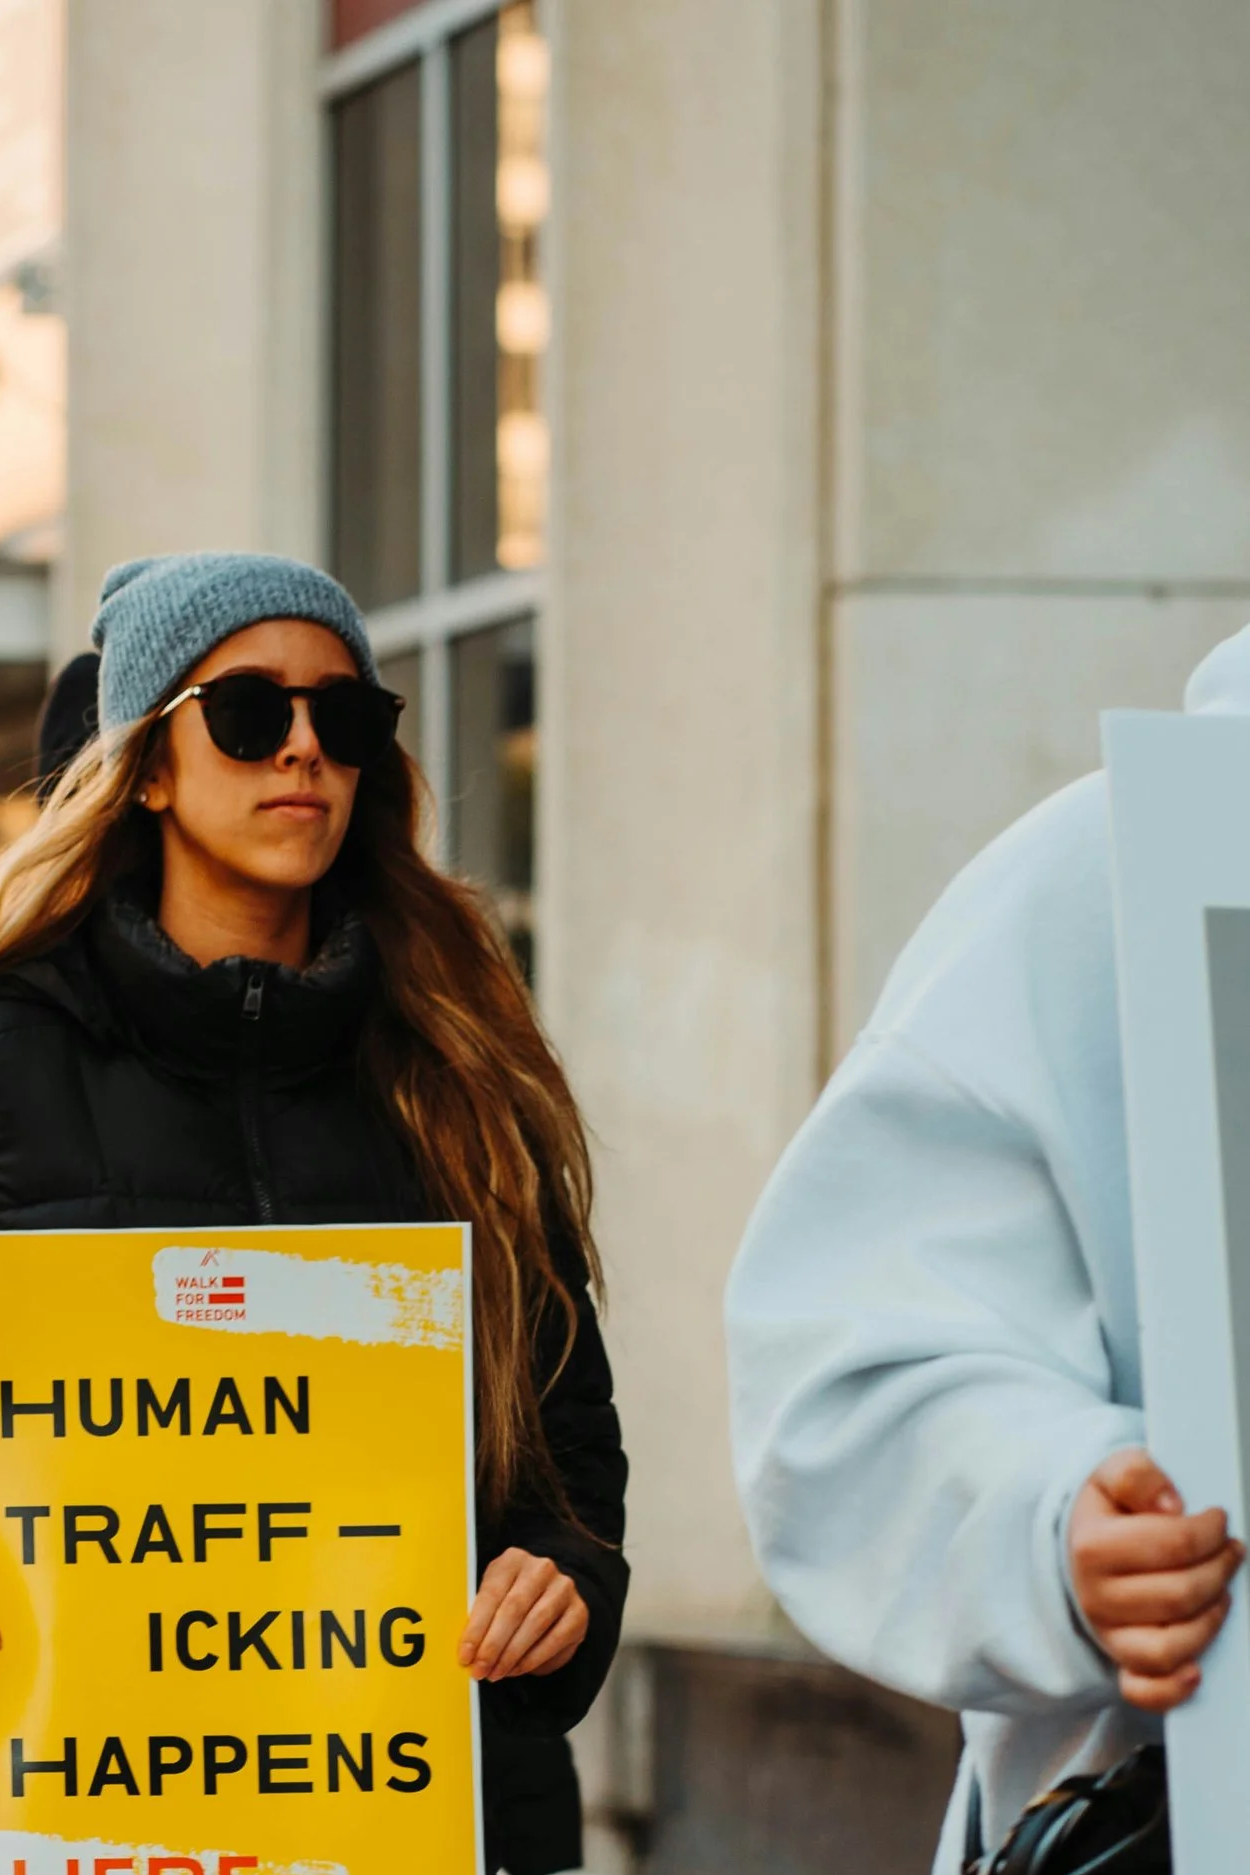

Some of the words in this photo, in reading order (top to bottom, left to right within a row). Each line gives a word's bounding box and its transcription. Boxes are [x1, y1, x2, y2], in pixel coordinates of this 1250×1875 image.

[175, 1276, 218, 1289] WALK
[175, 1293, 205, 1305] FOR
[176, 1309, 247, 1322] FREEDOM
[0, 1375, 310, 1439] HUMAN
[148, 1606, 426, 1672] ICKING
[10, 1731, 432, 1798] HAPPENS
